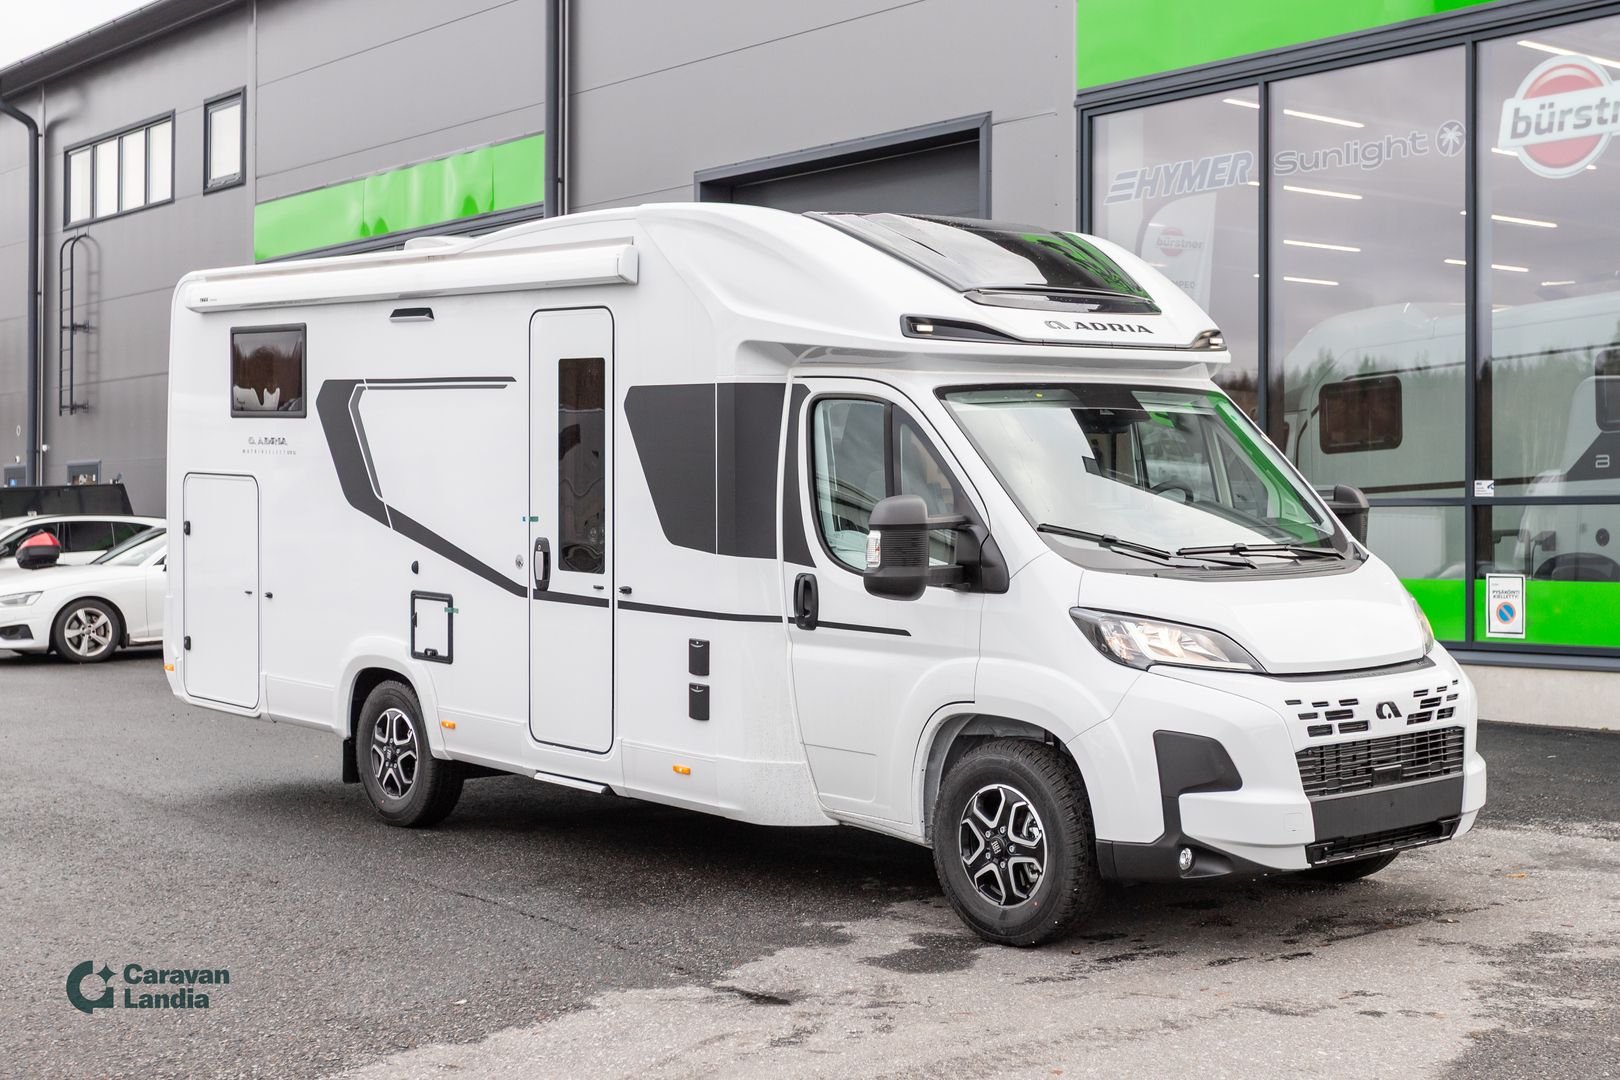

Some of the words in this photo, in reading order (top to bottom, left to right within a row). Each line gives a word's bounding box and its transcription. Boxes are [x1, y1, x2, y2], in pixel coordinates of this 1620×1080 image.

[1274, 131, 1429, 176] Sunlight
[1133, 151, 1254, 200] HYMER
[1156, 237, 1204, 249] bürstner
[1074, 321, 1154, 334] ADRIA
